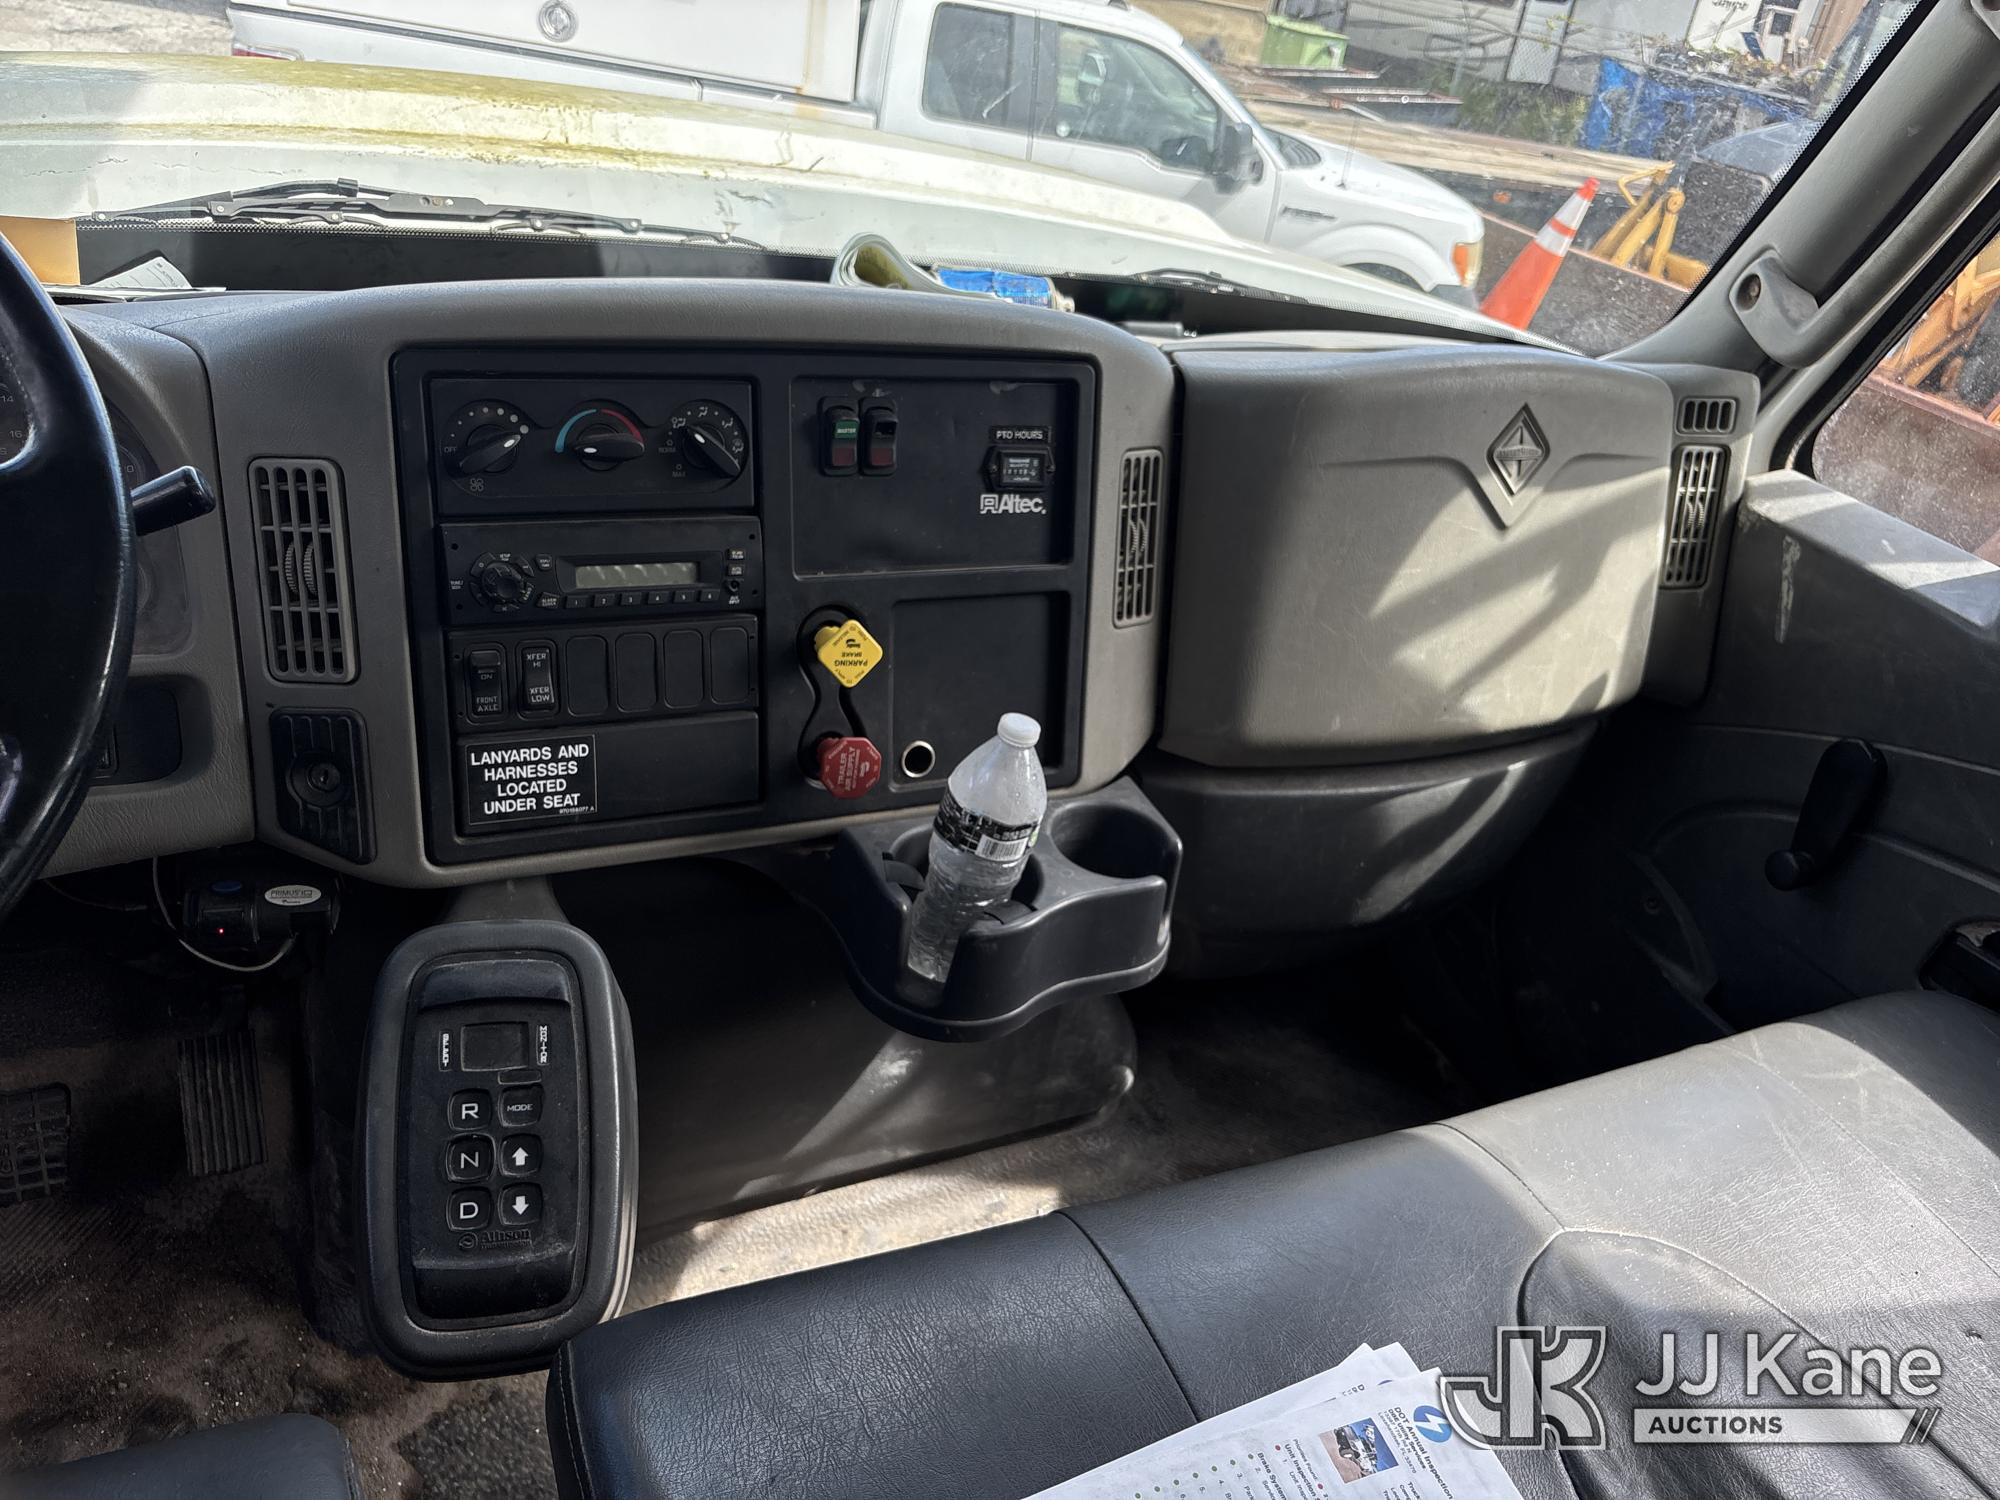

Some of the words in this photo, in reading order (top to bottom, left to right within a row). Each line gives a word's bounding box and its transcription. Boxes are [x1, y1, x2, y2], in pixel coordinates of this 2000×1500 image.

[996, 430, 1013, 440] PTO
[1014, 430, 1043, 440] HOURS
[529, 686, 550, 695] XFER
[476, 696, 498, 704] FRONT
[477, 704, 498, 712] AXLE
[471, 746, 552, 766] LANYARDS
[558, 744, 589, 759] AND
[484, 761, 578, 782] HARNESSES
[497, 778, 567, 797] LOCATED
[484, 797, 537, 815] UNDER
[543, 793, 580, 809] SEAT
[540, 1025, 548, 1063] MONITOR
[461, 1103, 479, 1120] R
[506, 1103, 534, 1112] MODE
[460, 1152, 479, 1169] N
[459, 1202, 479, 1220] D
[1393, 1405, 1409, 1425] DOT
[1405, 1424, 1427, 1455] Annual
[1422, 1454, 1454, 1500] Inspection
[1407, 1440, 1427, 1469] Services
[1257, 1451, 1272, 1473] Brake
[1284, 1443, 1296, 1458] Unit
[1291, 1458, 1317, 1497] Inspection
[1288, 1470, 1299, 1483] Unit
